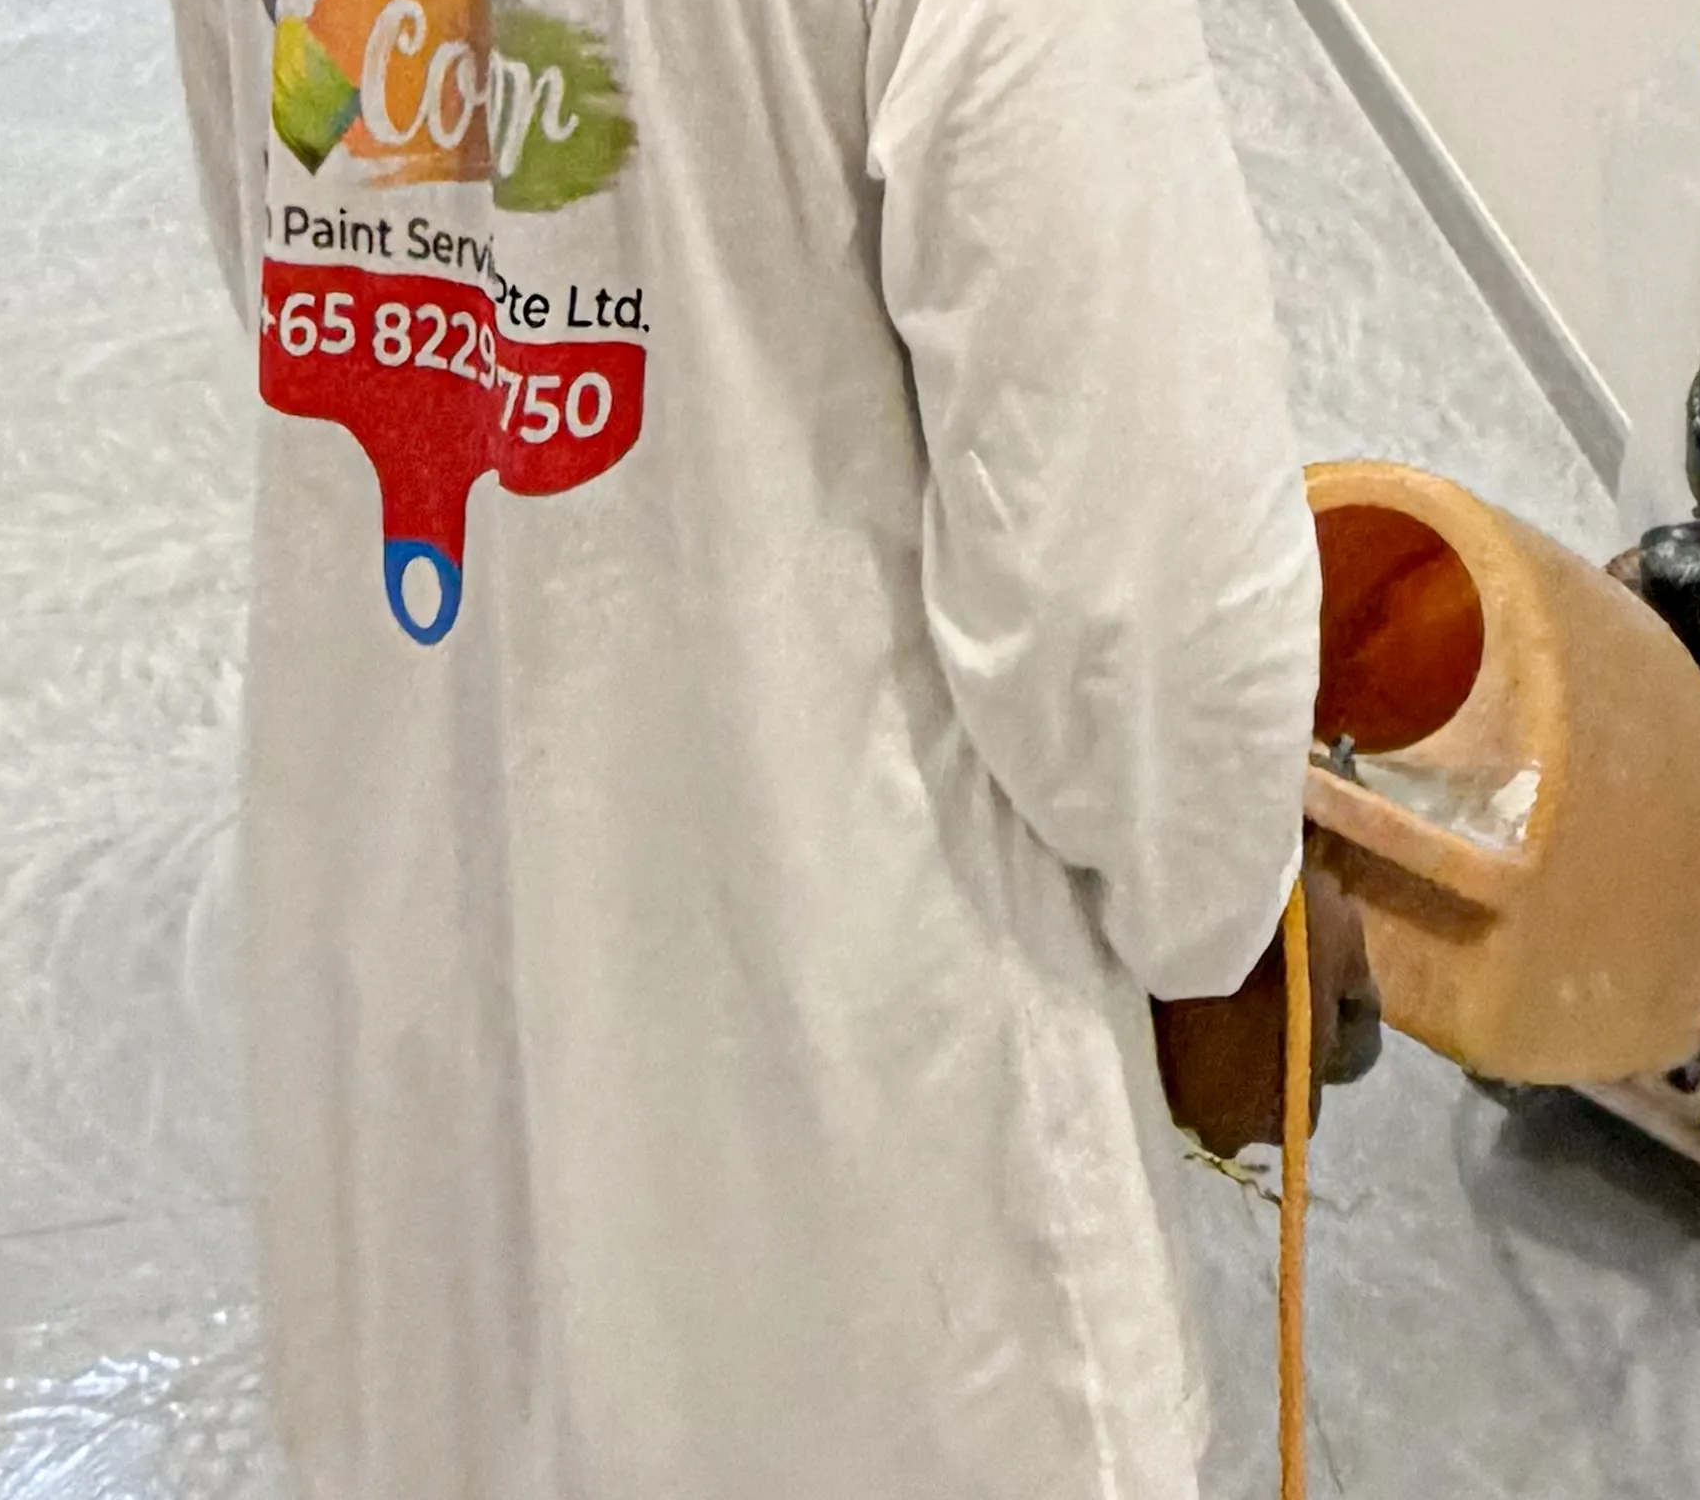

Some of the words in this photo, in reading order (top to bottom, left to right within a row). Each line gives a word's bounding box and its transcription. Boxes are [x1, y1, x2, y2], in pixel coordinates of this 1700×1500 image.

[283, 205, 393, 257] Paint
[407, 217, 496, 274] Servi
[567, 284, 650, 333] Ltd.
[260, 291, 357, 357] +65
